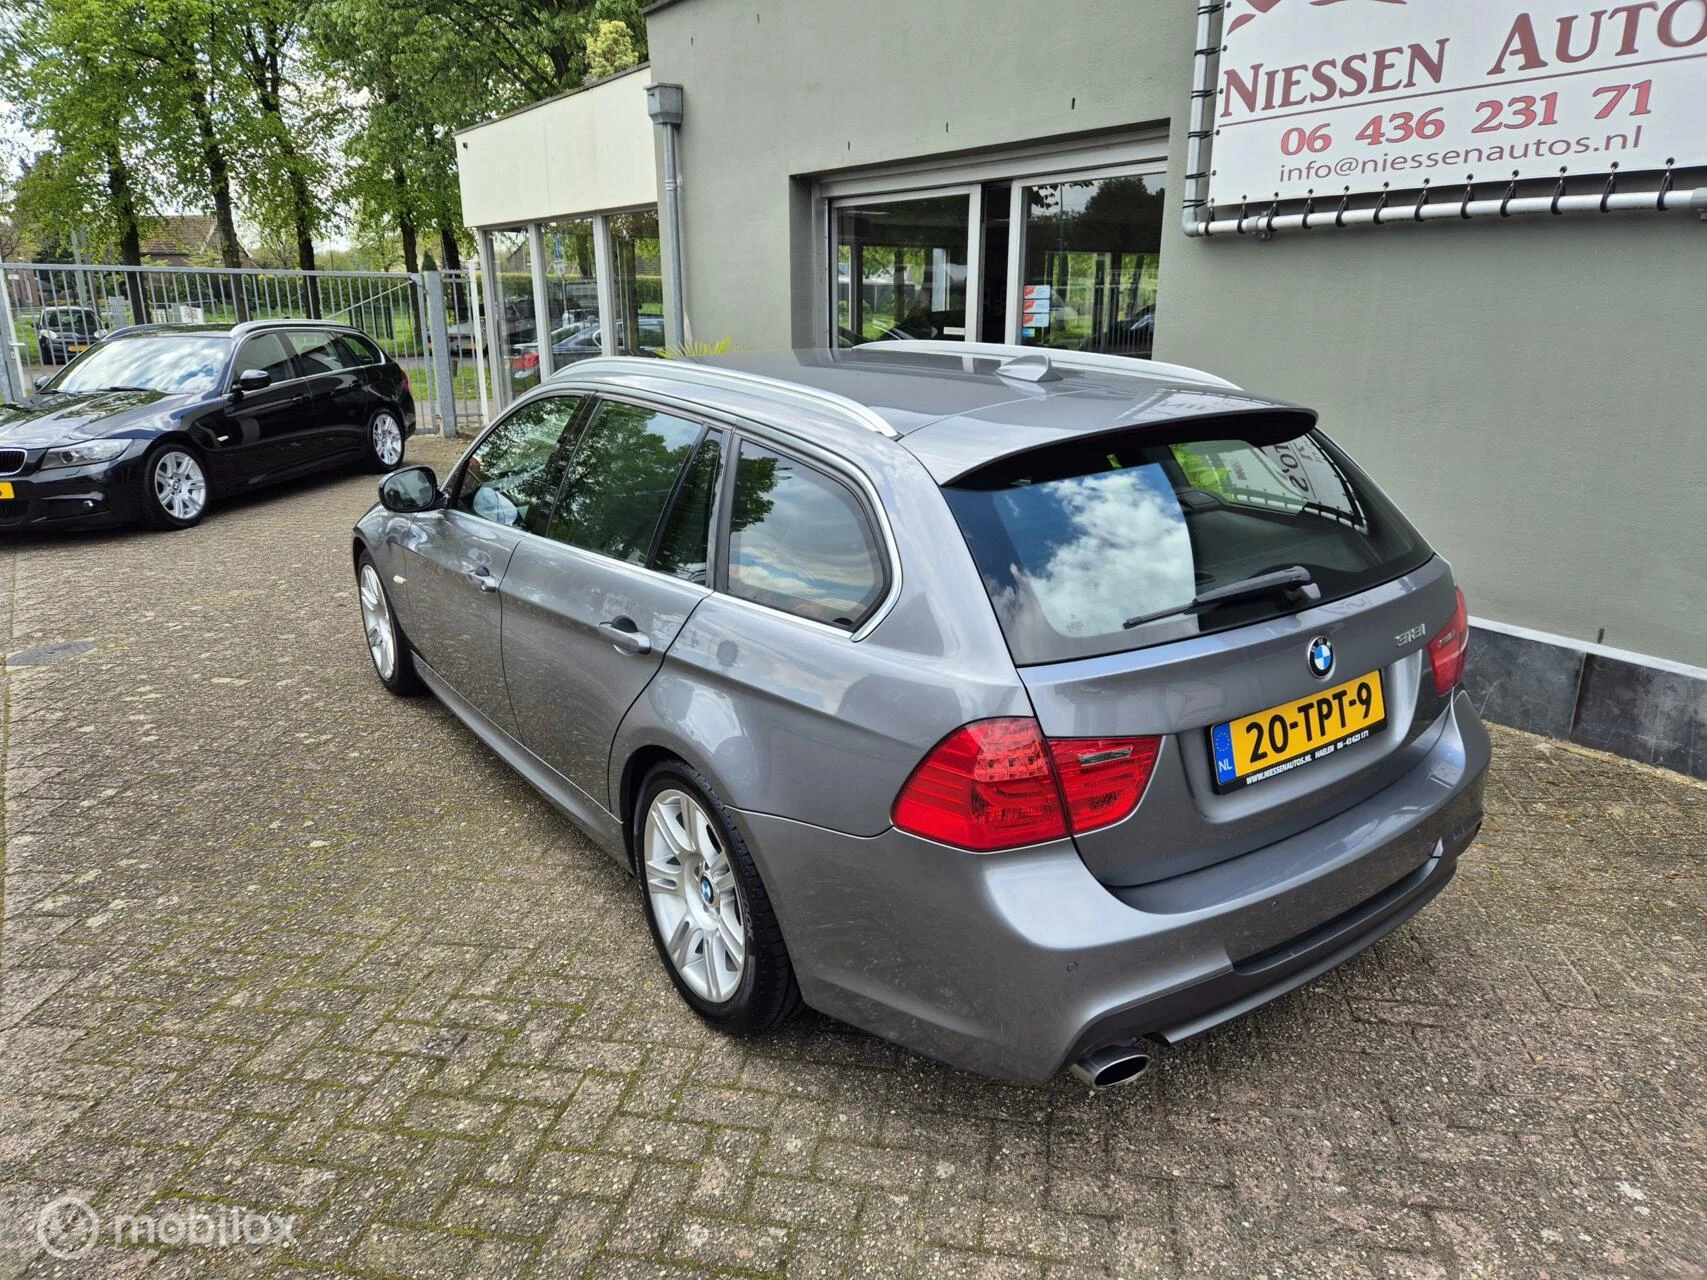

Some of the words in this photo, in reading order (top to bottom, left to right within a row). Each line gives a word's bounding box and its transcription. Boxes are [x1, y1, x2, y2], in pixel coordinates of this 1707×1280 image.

[1220, 38, 1450, 117] NIESSEN
[1280, 122, 1332, 155] 06
[1355, 107, 1445, 146] 436
[1471, 91, 1558, 134] 231
[1592, 79, 1652, 120] 71
[1280, 125, 1642, 183] info@niessenautos.nl
[1246, 682, 1372, 763] 20-TPT-9
[1218, 760, 1233, 772] NL
